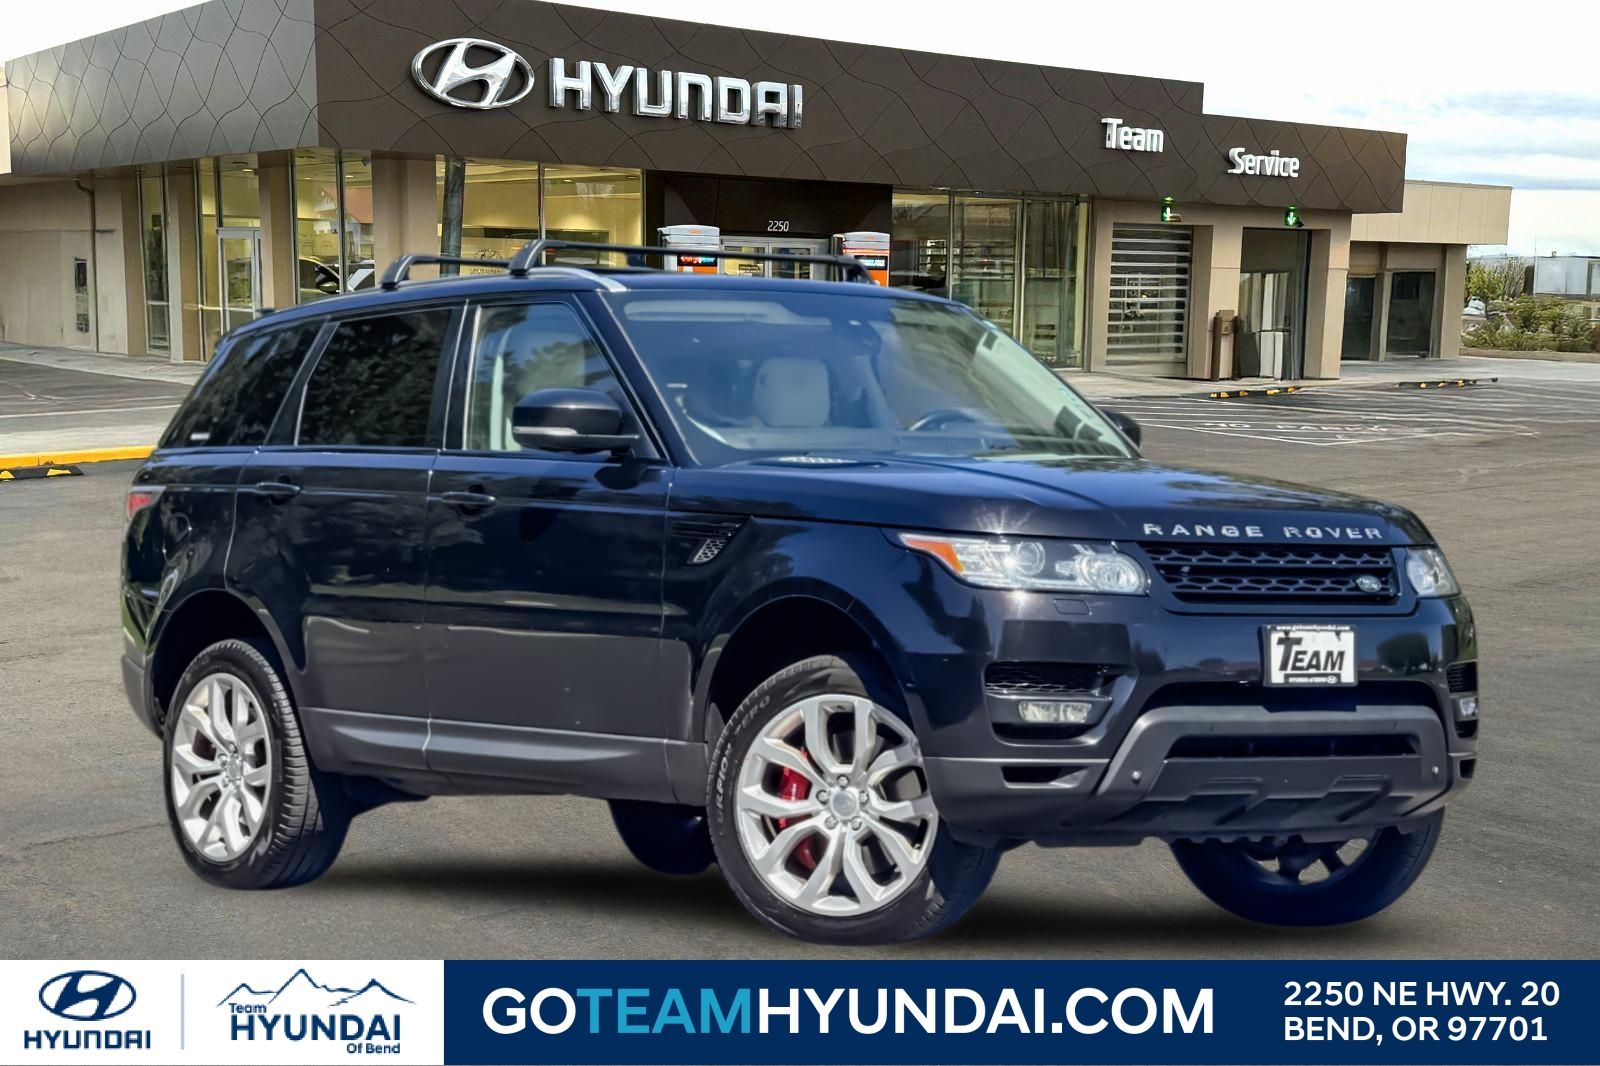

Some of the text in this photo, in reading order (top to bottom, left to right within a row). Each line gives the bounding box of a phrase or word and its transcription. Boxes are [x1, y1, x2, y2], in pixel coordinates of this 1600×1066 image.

[549, 57, 803, 129] HYUNDAI
[1101, 117, 1164, 153] Team
[1227, 147, 1300, 178] Service
[767, 220, 790, 232] 2250
[1143, 523, 1383, 540] RANGE ROVER
